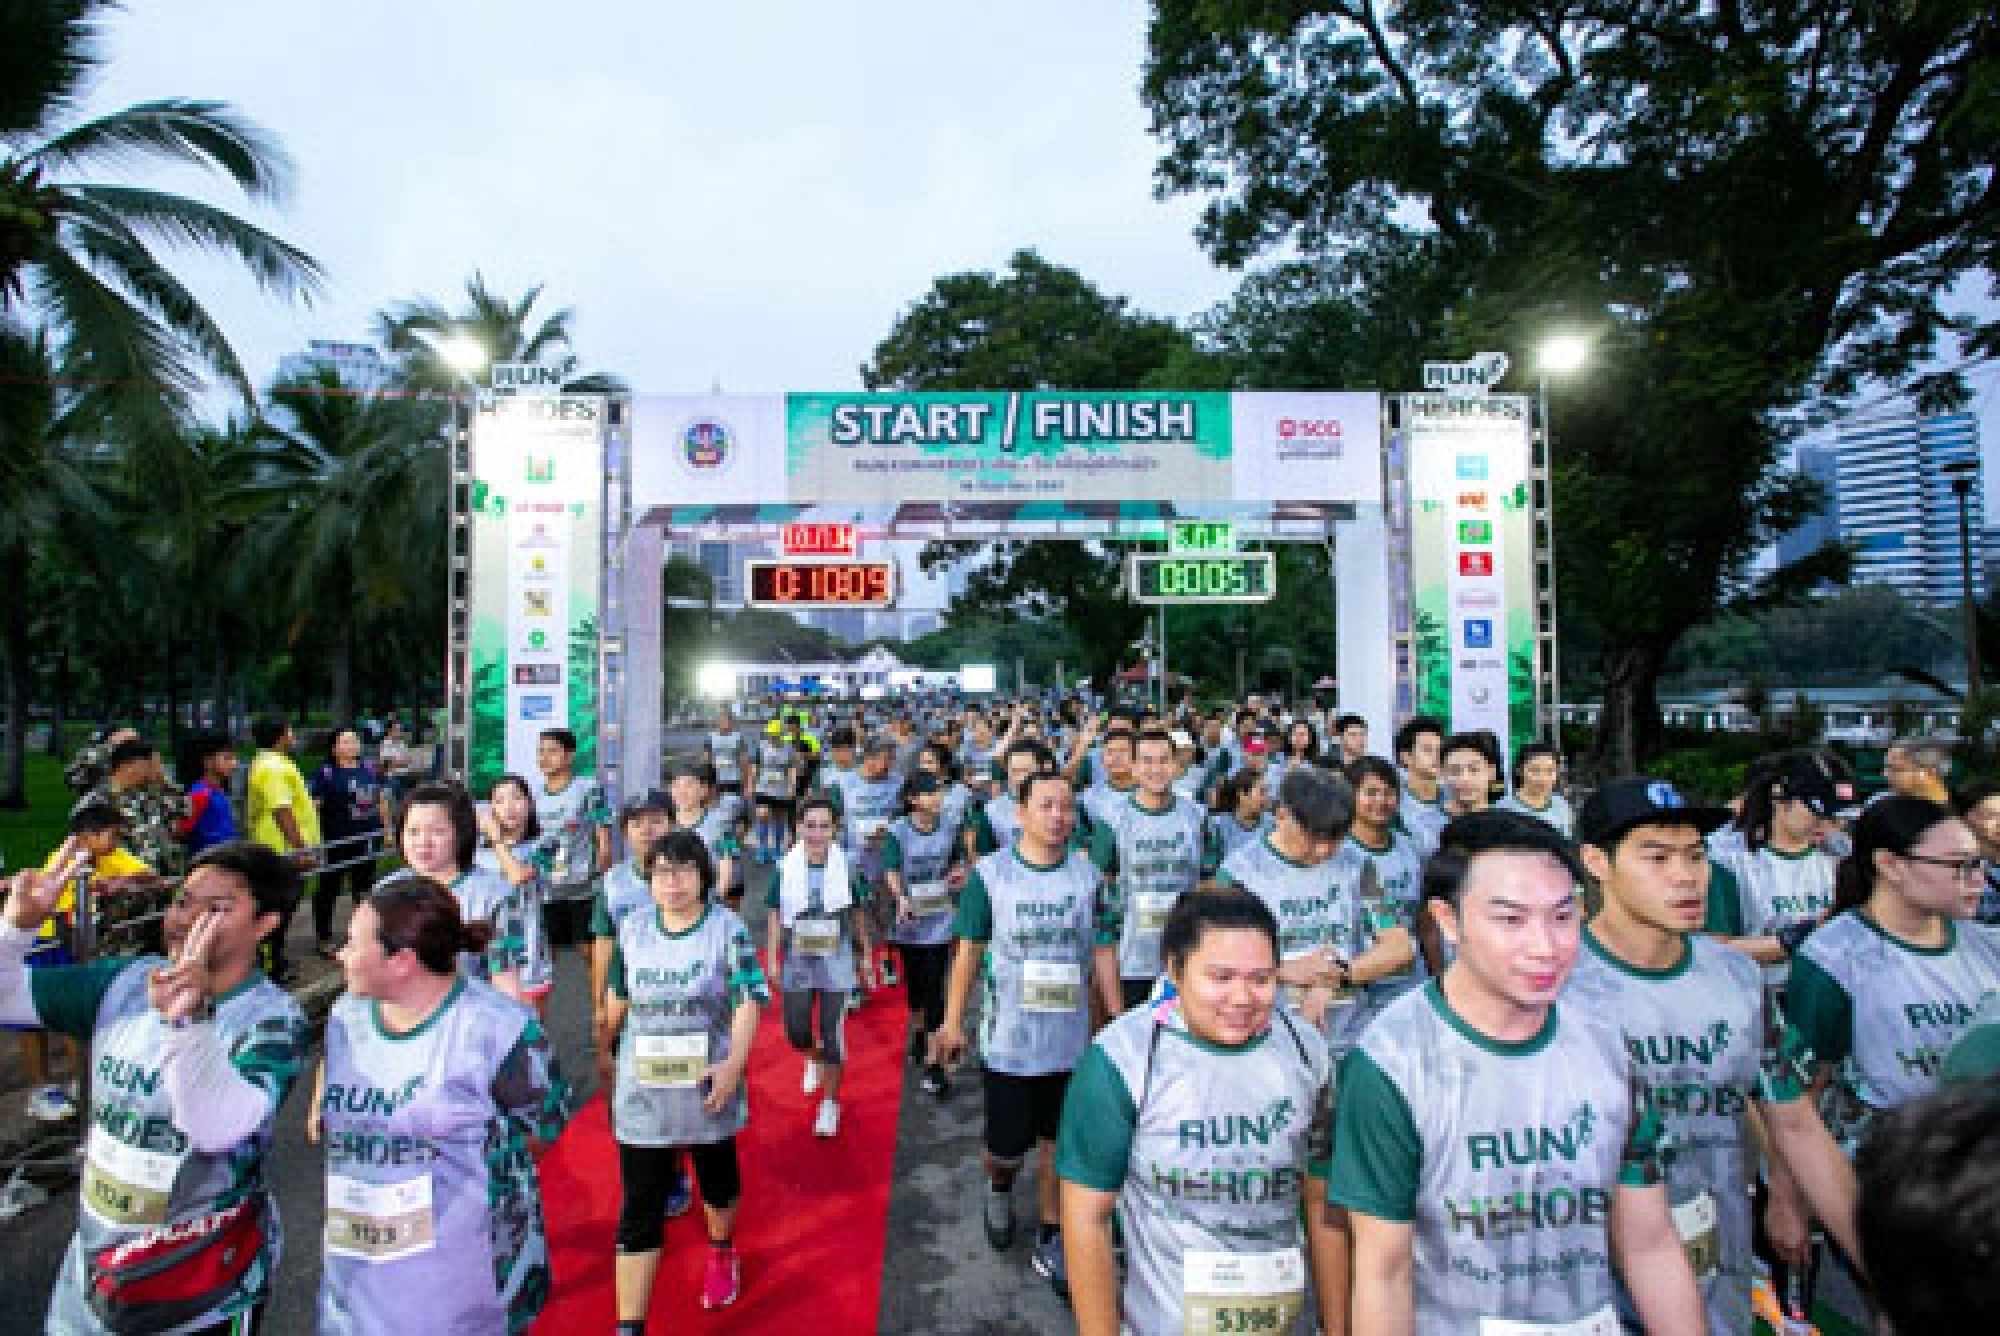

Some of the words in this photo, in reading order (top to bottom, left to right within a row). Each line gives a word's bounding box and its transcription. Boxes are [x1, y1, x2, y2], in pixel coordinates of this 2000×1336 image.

[495, 366, 560, 385] RUN
[1427, 366, 1486, 385] RUN
[833, 402, 991, 442] START
[1034, 402, 1195, 440] FINISH
[1015, 901, 1066, 918] RUN
[1279, 896, 1329, 917] RUN
[1771, 894, 1829, 914] RUN
[634, 966, 690, 986] RUN
[1626, 1035, 1714, 1066] RUN
[97, 1053, 160, 1097] RUN
[324, 1085, 396, 1117] RUN
[1179, 1115, 1270, 1150] RUN
[1470, 1126, 1580, 1171] RUN
